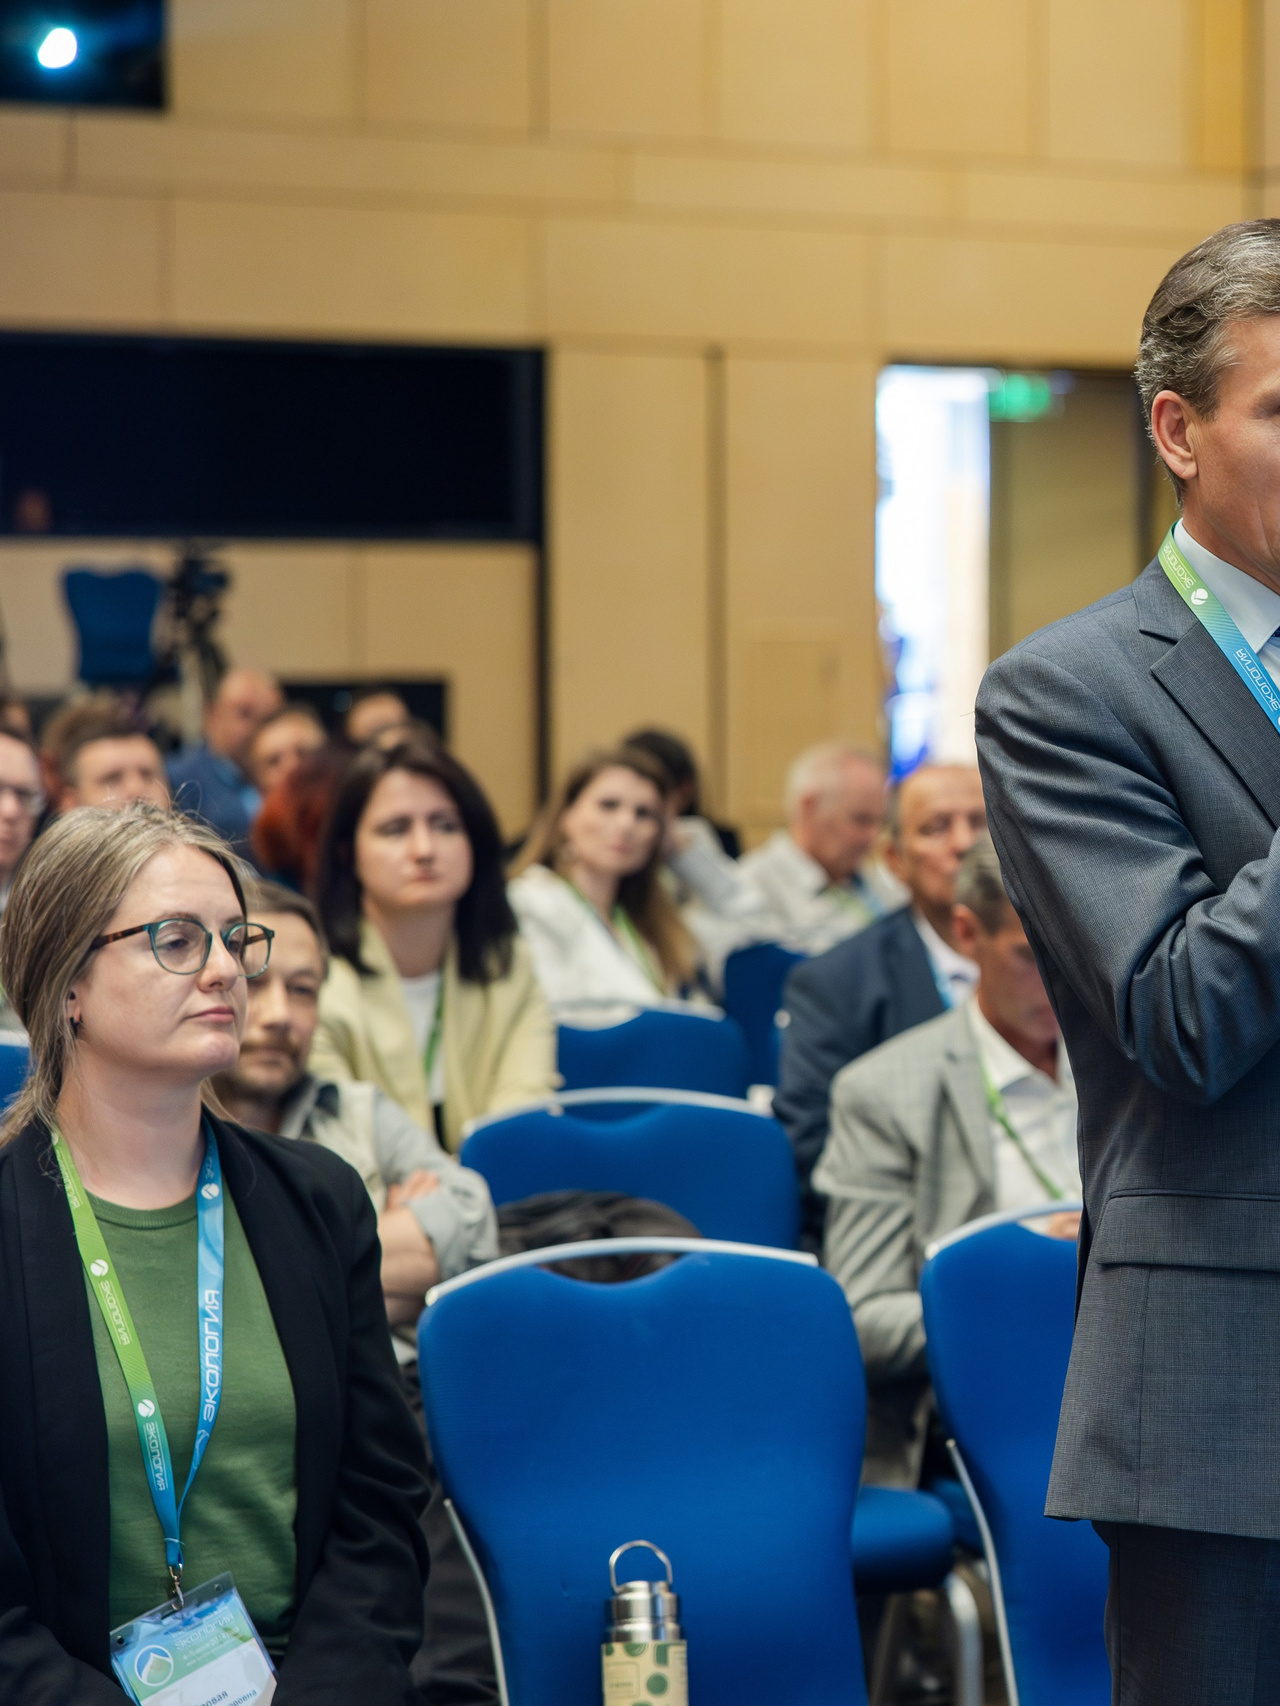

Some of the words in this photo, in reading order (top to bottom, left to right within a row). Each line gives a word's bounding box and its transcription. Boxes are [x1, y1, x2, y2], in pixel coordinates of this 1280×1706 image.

[1163, 543, 1195, 589] ЭКОЛОГИЯ
[1236, 648, 1280, 711] ЭКОЛОГИЯ
[100, 1280, 131, 1345] ЭКОЛОГИЯ
[203, 1289, 220, 1422] ЭКОЛОГИЯ
[145, 1422, 166, 1491] ЭКОЛОГИЯ
